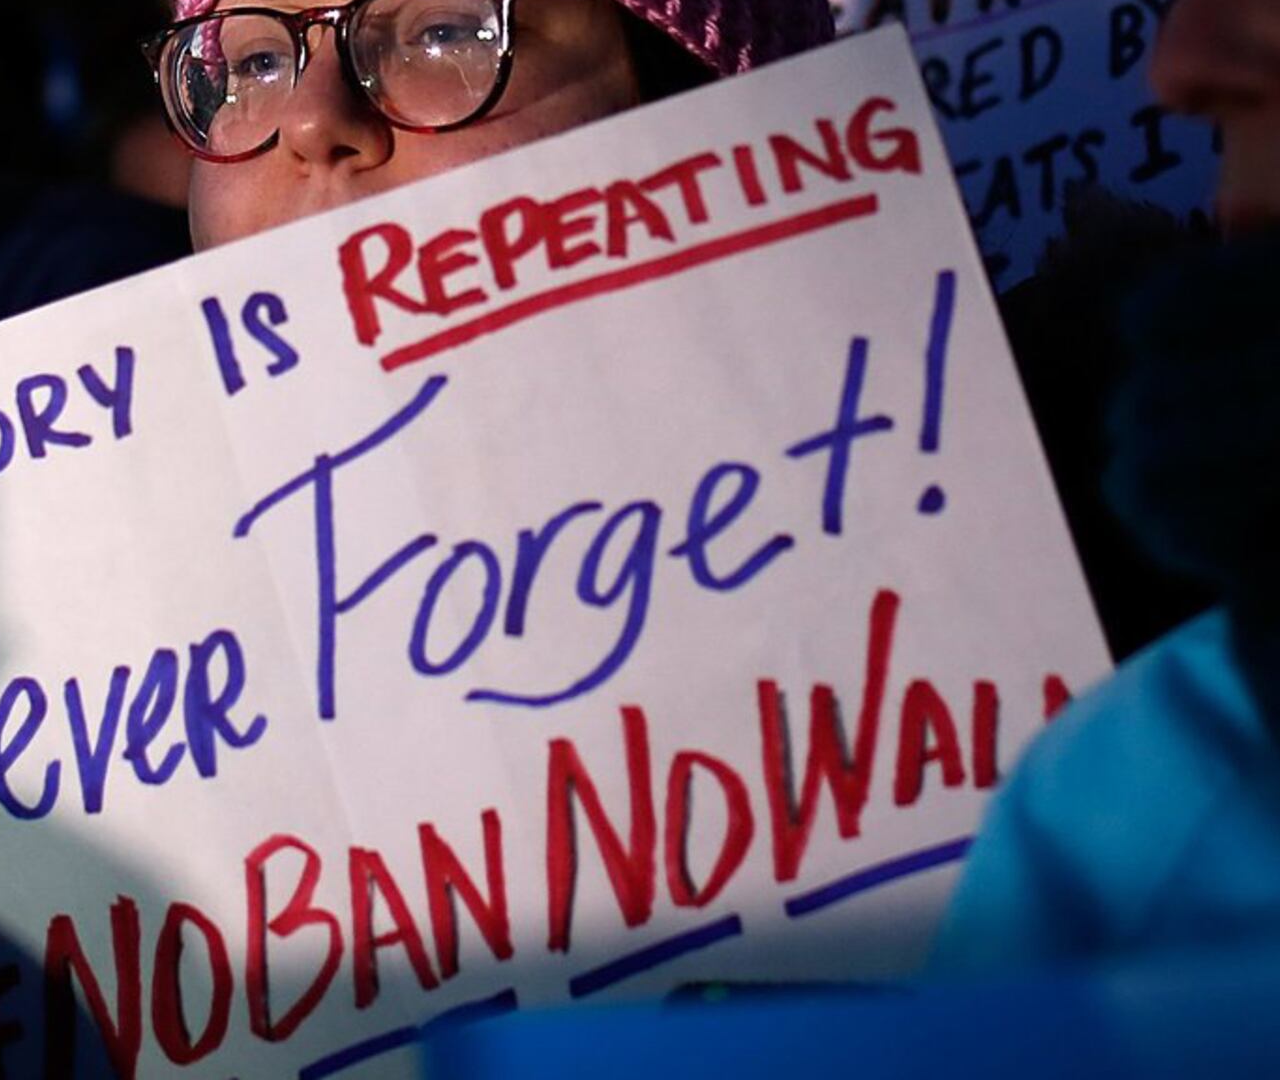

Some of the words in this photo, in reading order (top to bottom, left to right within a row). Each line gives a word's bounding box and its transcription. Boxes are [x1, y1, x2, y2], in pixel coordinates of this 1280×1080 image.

[200, 291, 300, 396] IS
[336, 96, 924, 347] REPEATING
[232, 269, 958, 721] Forget!
